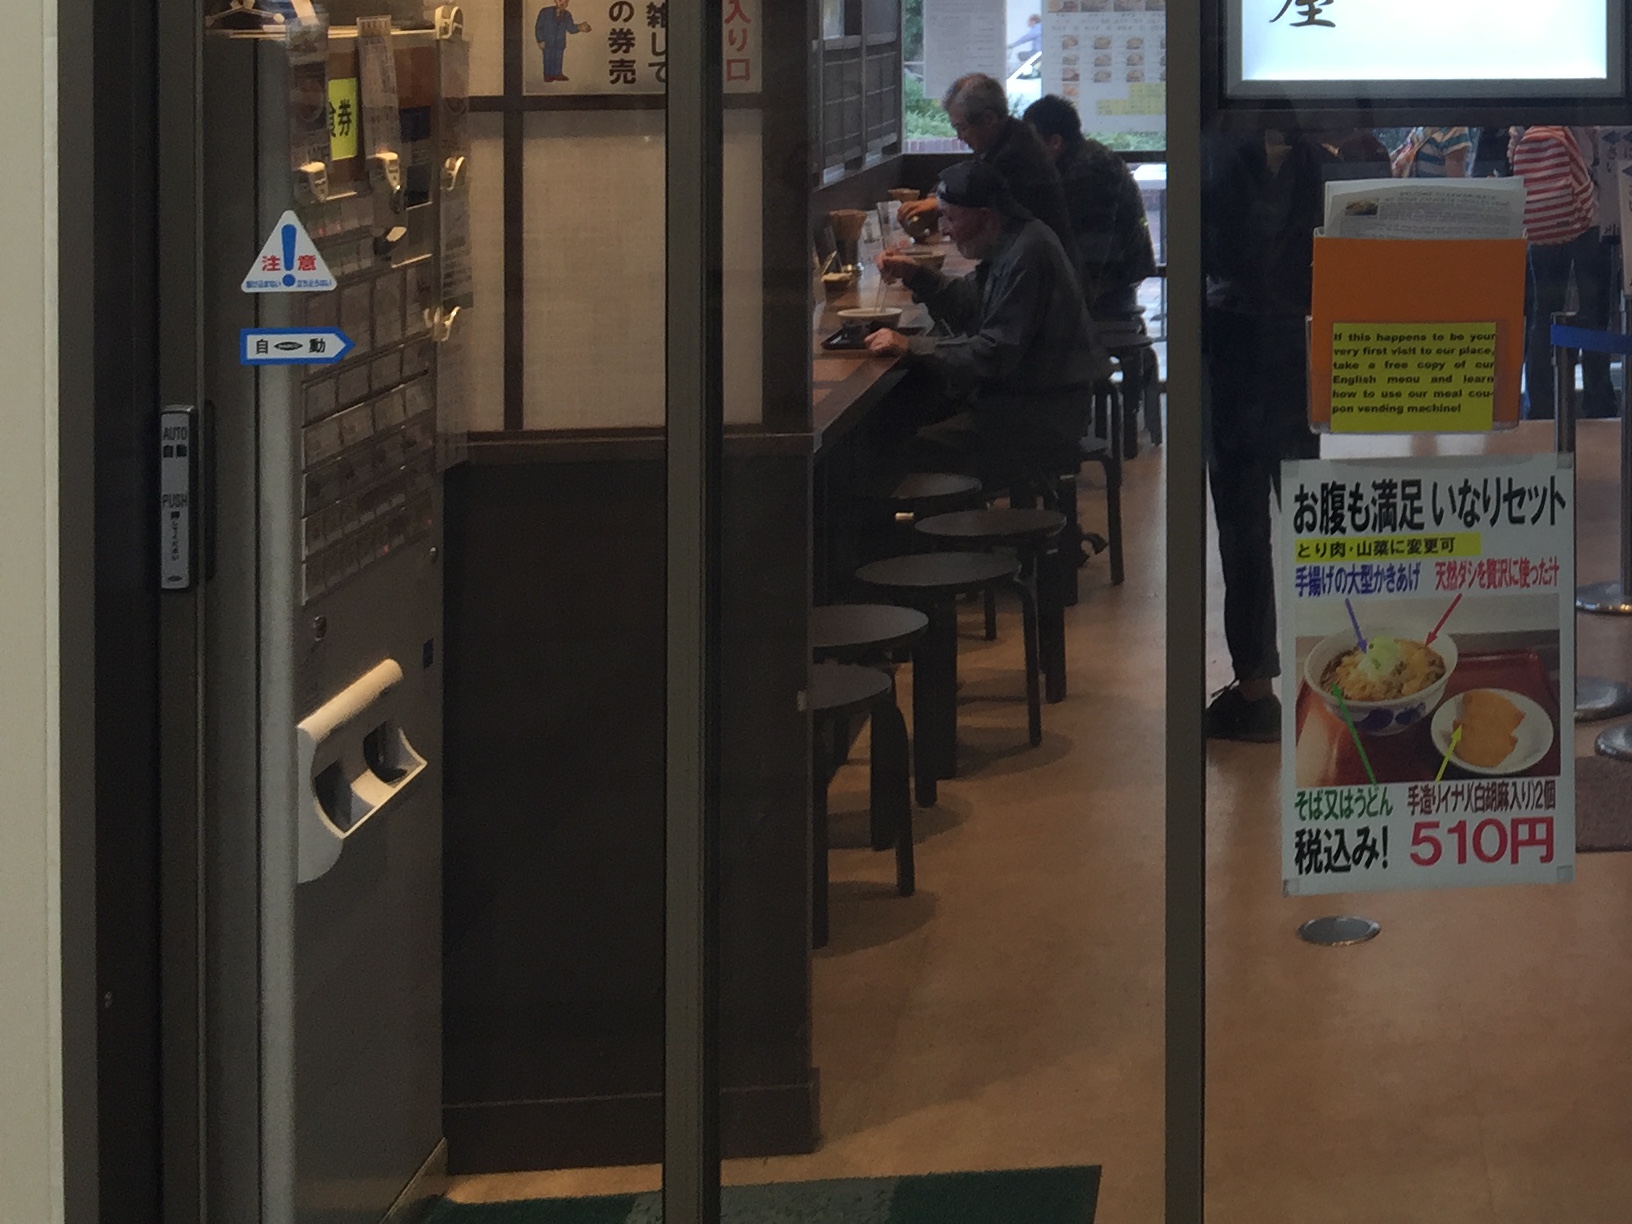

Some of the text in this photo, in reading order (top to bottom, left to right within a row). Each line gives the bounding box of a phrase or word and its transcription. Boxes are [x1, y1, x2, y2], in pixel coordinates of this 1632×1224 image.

[1349, 333, 1371, 341] this
[1376, 333, 1426, 342] happens
[1470, 333, 1496, 341] your
[1333, 348, 1359, 357] very
[1363, 347, 1387, 355] first
[1392, 347, 1416, 355] visit
[1333, 361, 1359, 369] take
[1385, 361, 1408, 369] free
[1417, 362, 1446, 370] copy
[1454, 360, 1466, 369] of
[1332, 375, 1376, 385] English
[1431, 375, 1453, 383] and
[1463, 375, 1494, 383] learn
[1332, 390, 1357, 398] how
[1363, 390, 1374, 398] to
[1434, 389, 1462, 398] meal
[1332, 404, 1461, 414] pon vending machine!
[163, 426, 188, 441] AUTO
[162, 493, 187, 508] PUSH
[1293, 476, 1566, 535] お腹も満足 いなりセット
[1295, 562, 1422, 598] 手揚げの大型かきあげ
[1435, 556, 1560, 591] 天然ダシを贅沢に使った汁
[1294, 784, 1393, 821] そば又はうどん
[1409, 816, 1554, 866] 510円
[1294, 825, 1388, 876] 税込み!
